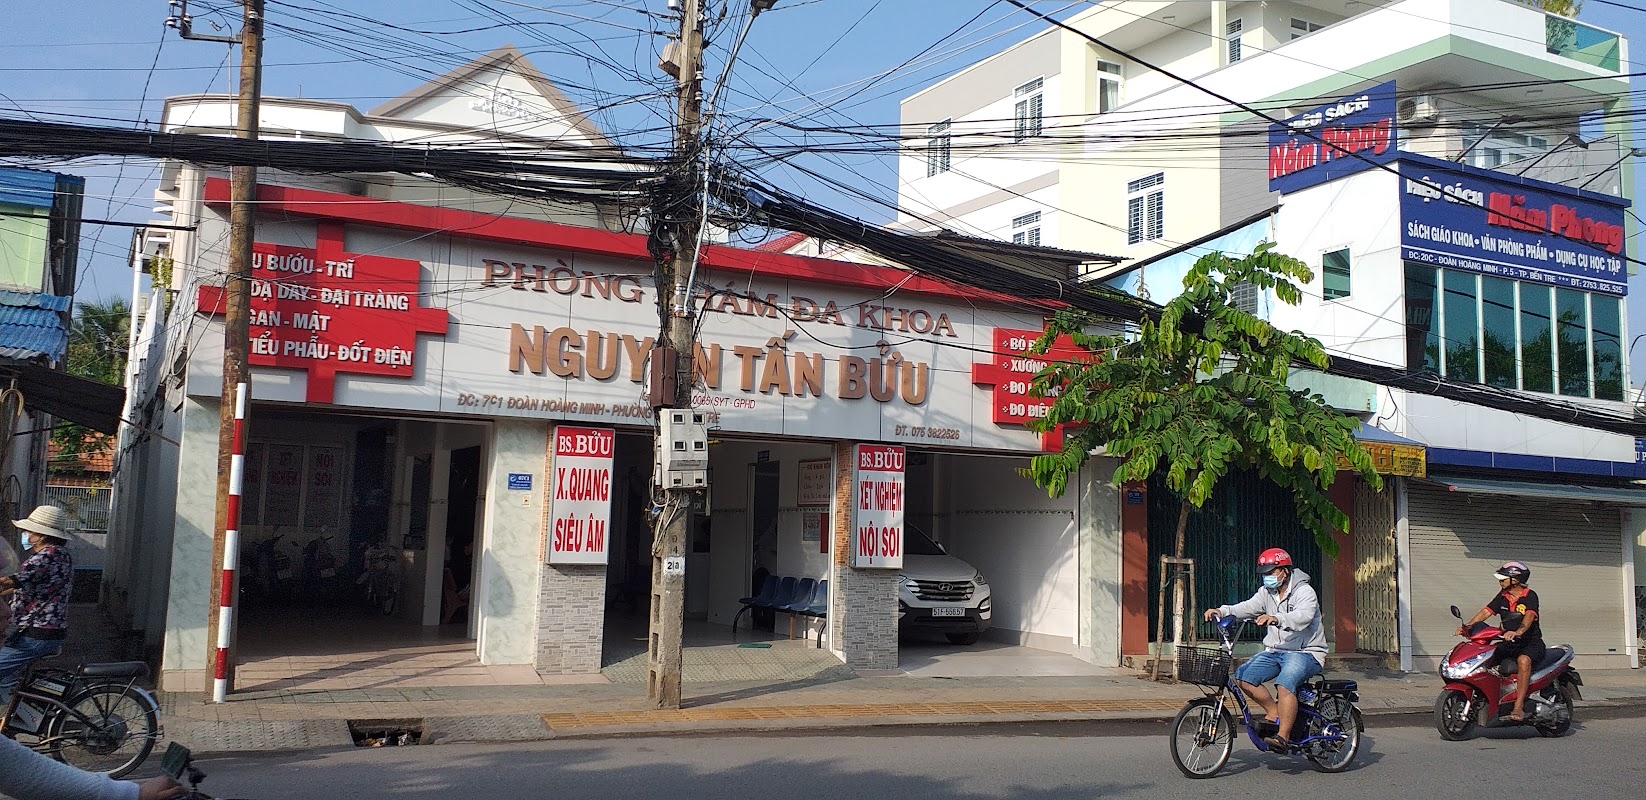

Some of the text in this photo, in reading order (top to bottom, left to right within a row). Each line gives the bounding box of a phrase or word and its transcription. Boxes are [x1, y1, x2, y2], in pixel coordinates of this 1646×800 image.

[1325, 95, 1369, 121] SÁCH
[1269, 117, 1392, 180] Năm Phong
[1444, 183, 1483, 206] SÁCH
[1488, 192, 1547, 233] Năm
[1551, 204, 1624, 254] Phong
[1408, 220, 1621, 275] SÁCH GIÁO KHOA VĂN PHÒNG PHẨM DỤNG CỤ HỌC TẬP
[267, 252, 316, 273] BƯỚU
[326, 259, 354, 278] TRĨ
[1439, 256, 1457, 266] ĐOÀN
[1458, 260, 1480, 270] HOÀNG
[1483, 264, 1498, 273] MINH
[1530, 269, 1542, 280] BẾN
[1544, 274, 1556, 283] TRE
[251, 280, 272, 302] DẠ
[321, 288, 349, 308] ĐẠI
[354, 289, 409, 311] TRÀNG
[482, 259, 645, 303] PHÒNG
[791, 296, 846, 326] ĐA
[857, 303, 958, 337] KHOA
[293, 310, 330, 333] MẬT
[249, 331, 280, 355] IỂU
[374, 346, 412, 368] ĐIỆN
[1010, 335, 1026, 350] BÓ
[509, 322, 929, 404] NGUYN TẤN BỬU
[1009, 381, 1026, 394] ĐO
[507, 395, 537, 411] ĐOÀN
[540, 397, 578, 413] HOÀNG
[579, 402, 605, 416] MINH
[611, 403, 652, 419] PHƯỜNG
[1009, 403, 1026, 417] ĐO
[860, 474, 873, 510] XÉT
[875, 476, 902, 518] NGHIỆM
[554, 512, 605, 553] SIÊU ÂM
[860, 520, 878, 565] NỘI
[882, 527, 900, 558] SOI
